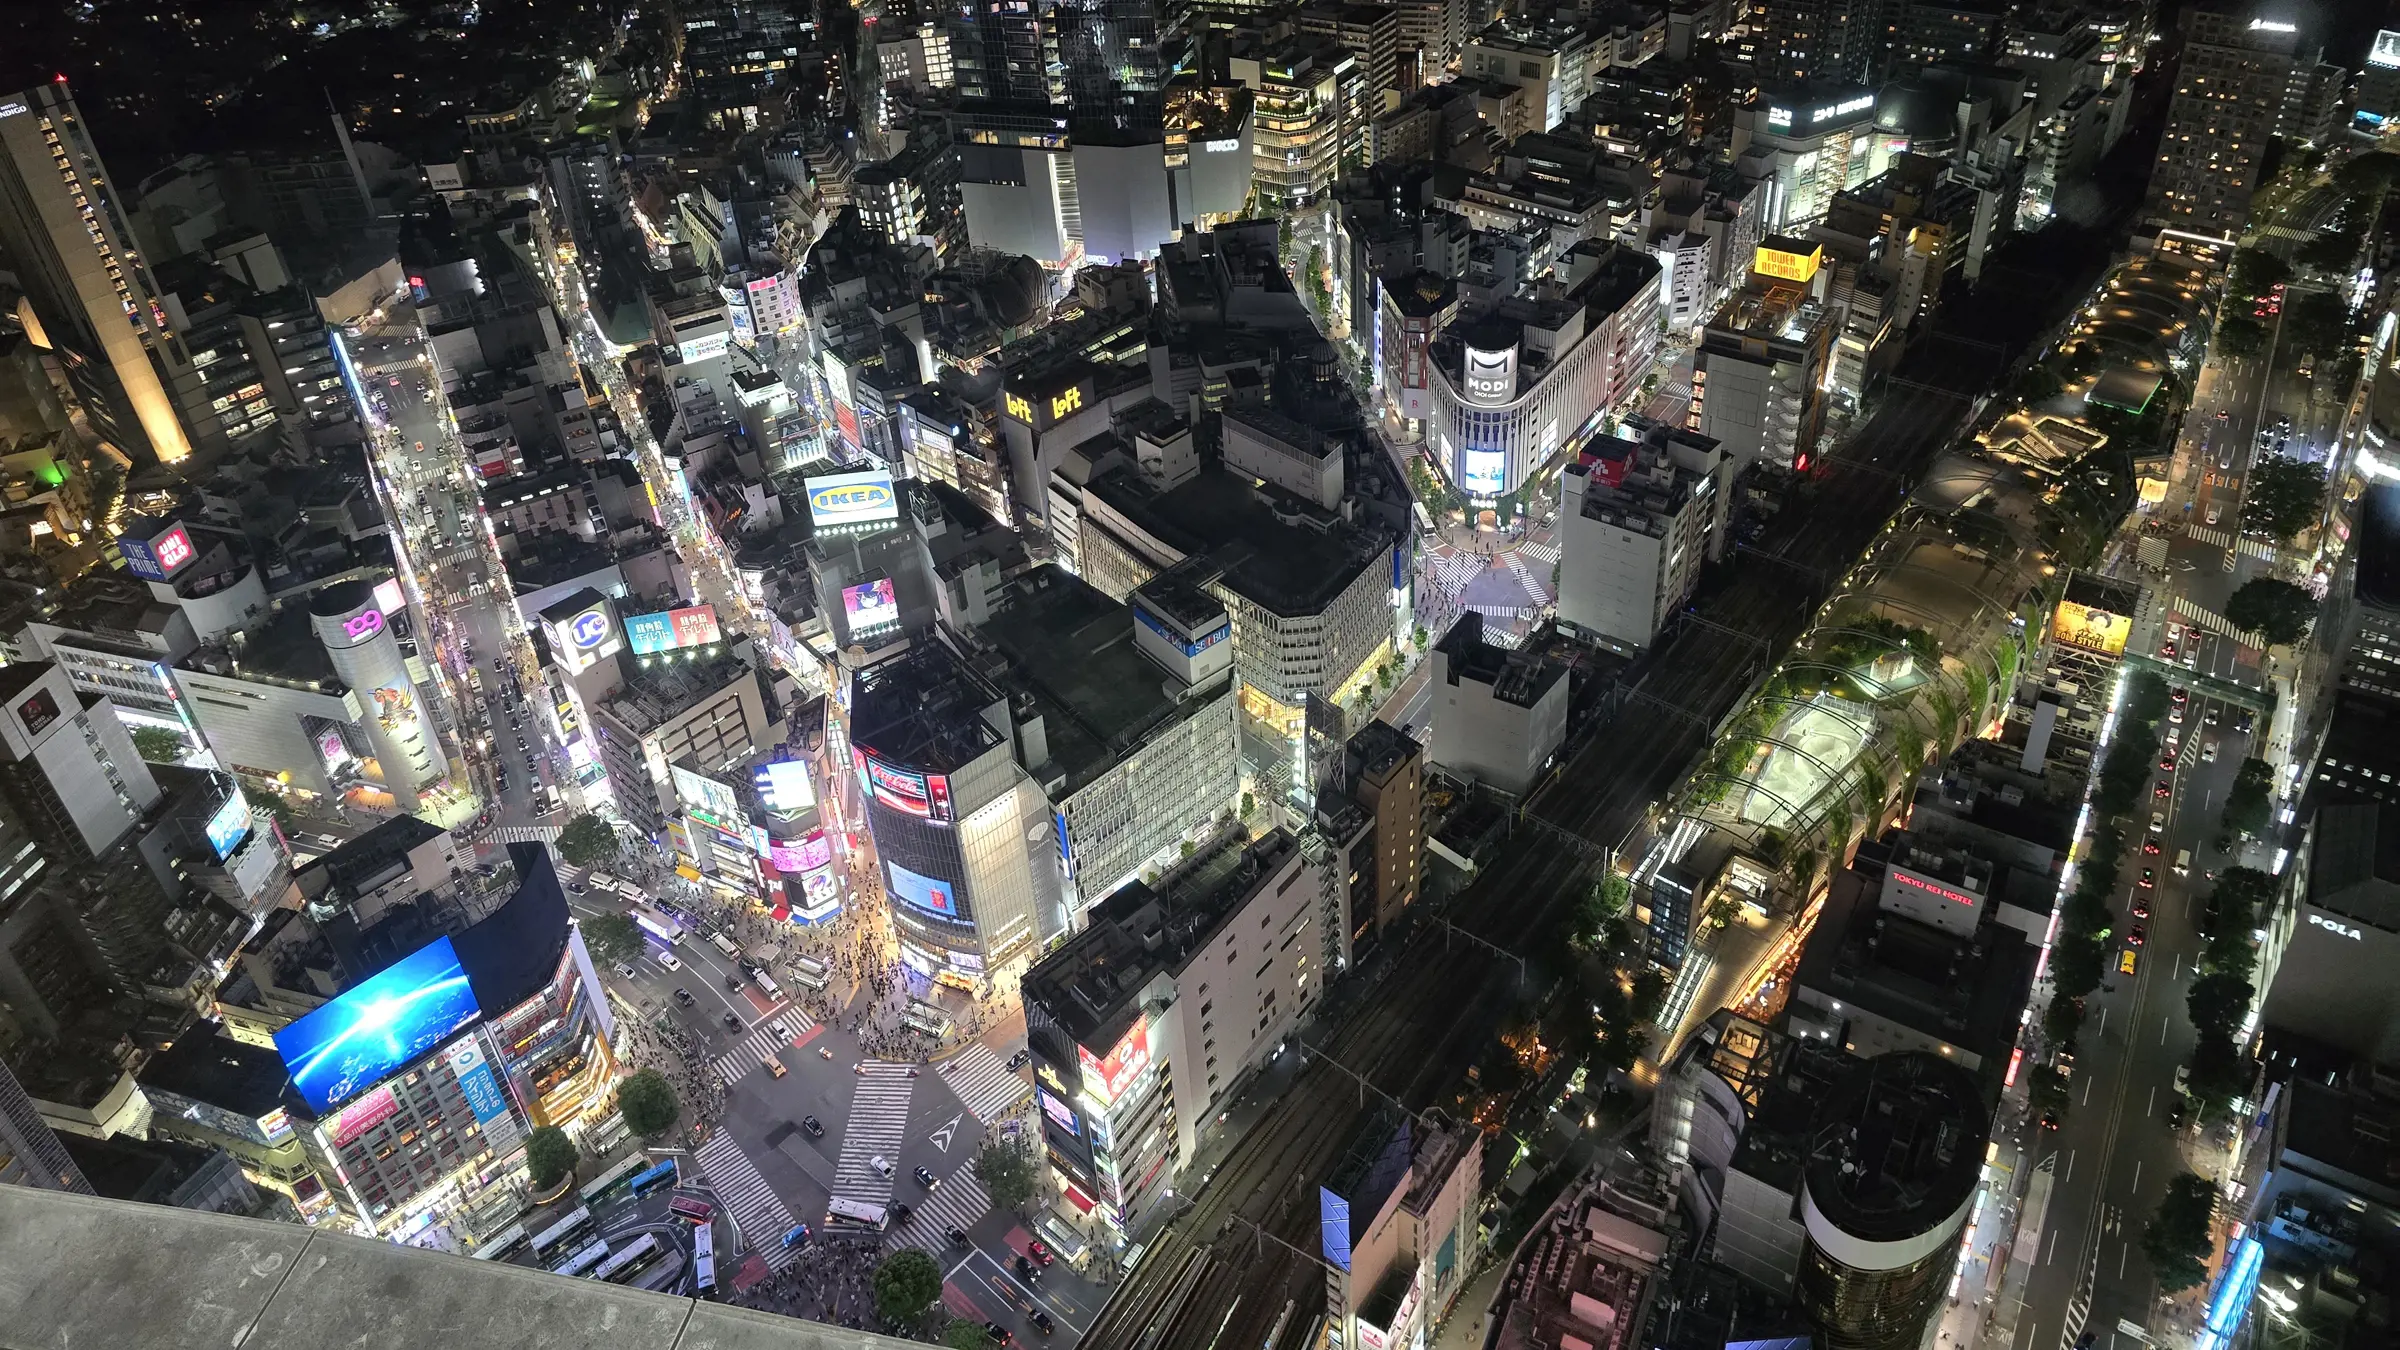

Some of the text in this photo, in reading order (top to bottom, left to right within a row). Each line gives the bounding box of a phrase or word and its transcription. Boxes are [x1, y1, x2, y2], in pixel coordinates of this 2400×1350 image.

[1206, 139, 1239, 152] PARCO
[1766, 250, 1796, 266] TOWER
[1761, 263, 1801, 279] RECORDS
[1468, 378, 1508, 392] MODI
[819, 489, 886, 506] IKEA
[126, 543, 148, 560] THE
[158, 533, 182, 555] UNI
[163, 543, 189, 566] QLO
[128, 557, 162, 575] PRIME
[342, 609, 383, 637] 109
[1195, 628, 1226, 653] SEIBU
[2055, 631, 2102, 649] GOLD STYLE
[873, 764, 919, 794] Coca-Cola
[1893, 872, 1974, 906] TOKYU REI HOTEL
[2308, 914, 2361, 940] POLA
[343, 1106, 395, 1141] 品川美容外科
